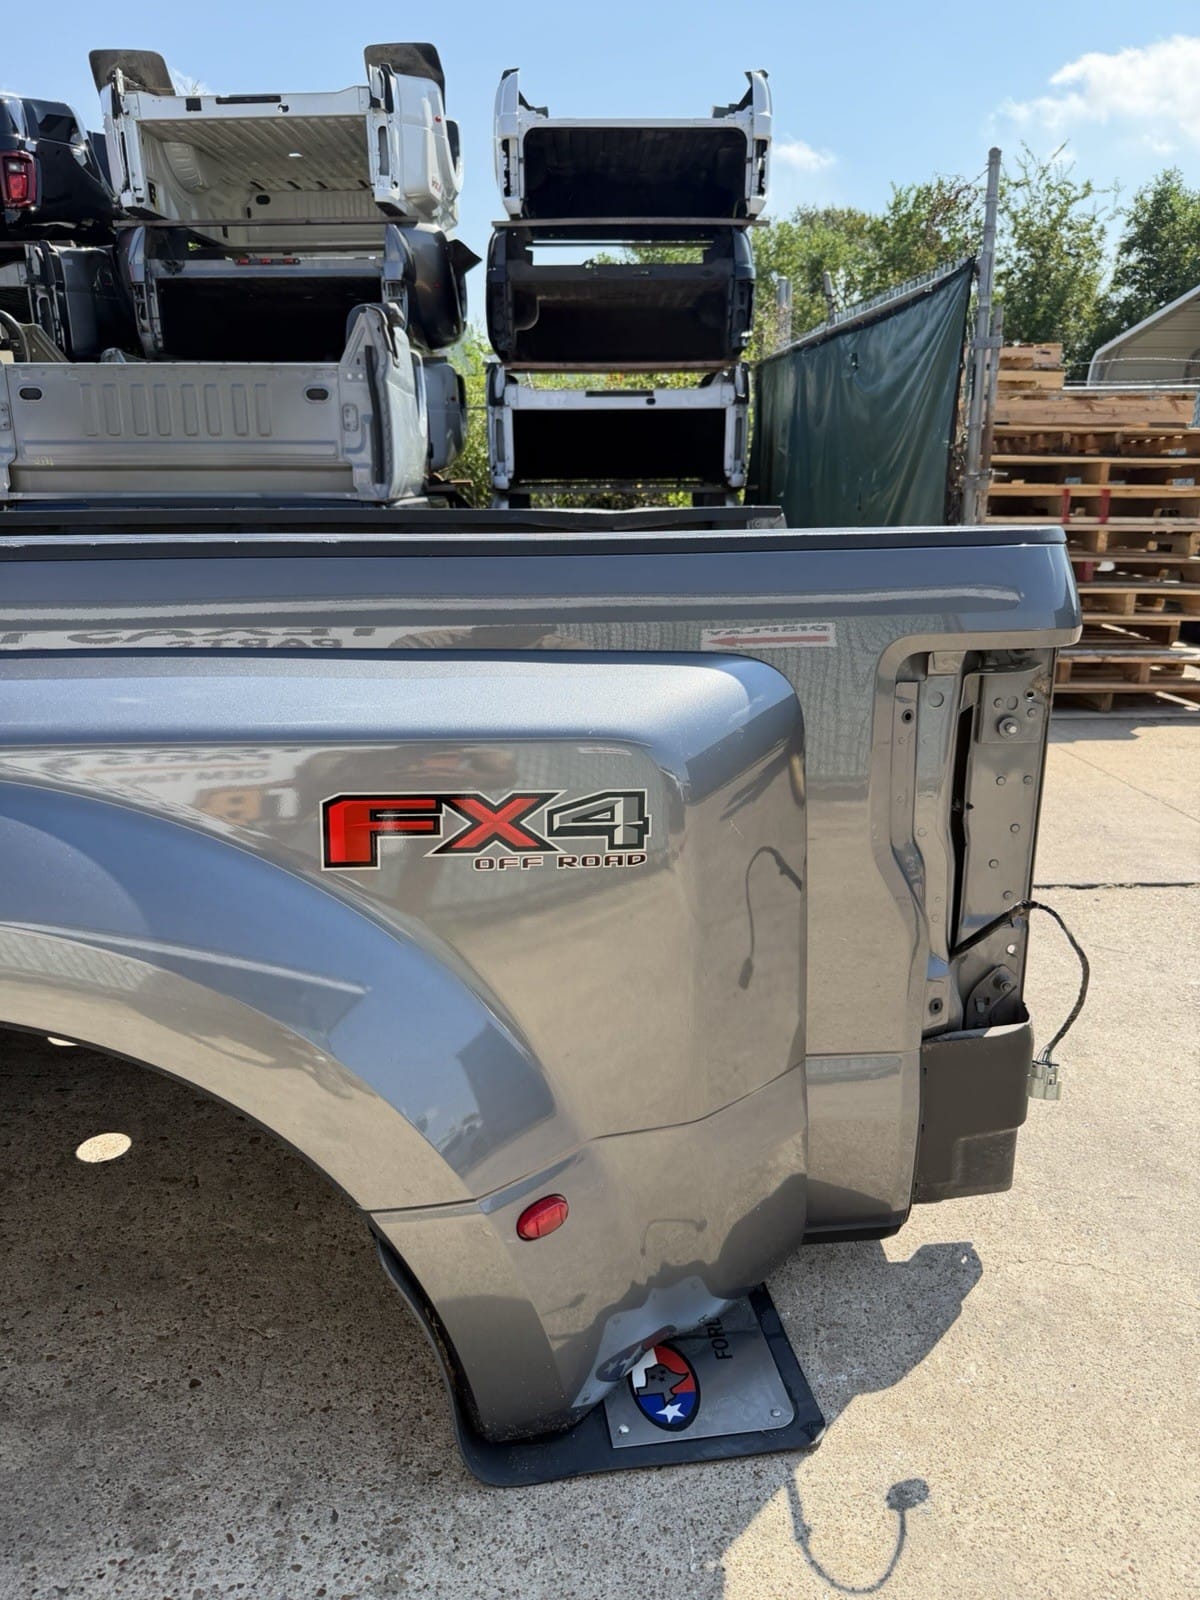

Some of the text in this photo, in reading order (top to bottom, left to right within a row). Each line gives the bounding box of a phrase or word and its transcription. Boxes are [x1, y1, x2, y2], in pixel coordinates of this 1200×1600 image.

[320, 789, 651, 871] FX4
[473, 853, 647, 871] OFF ROAD
